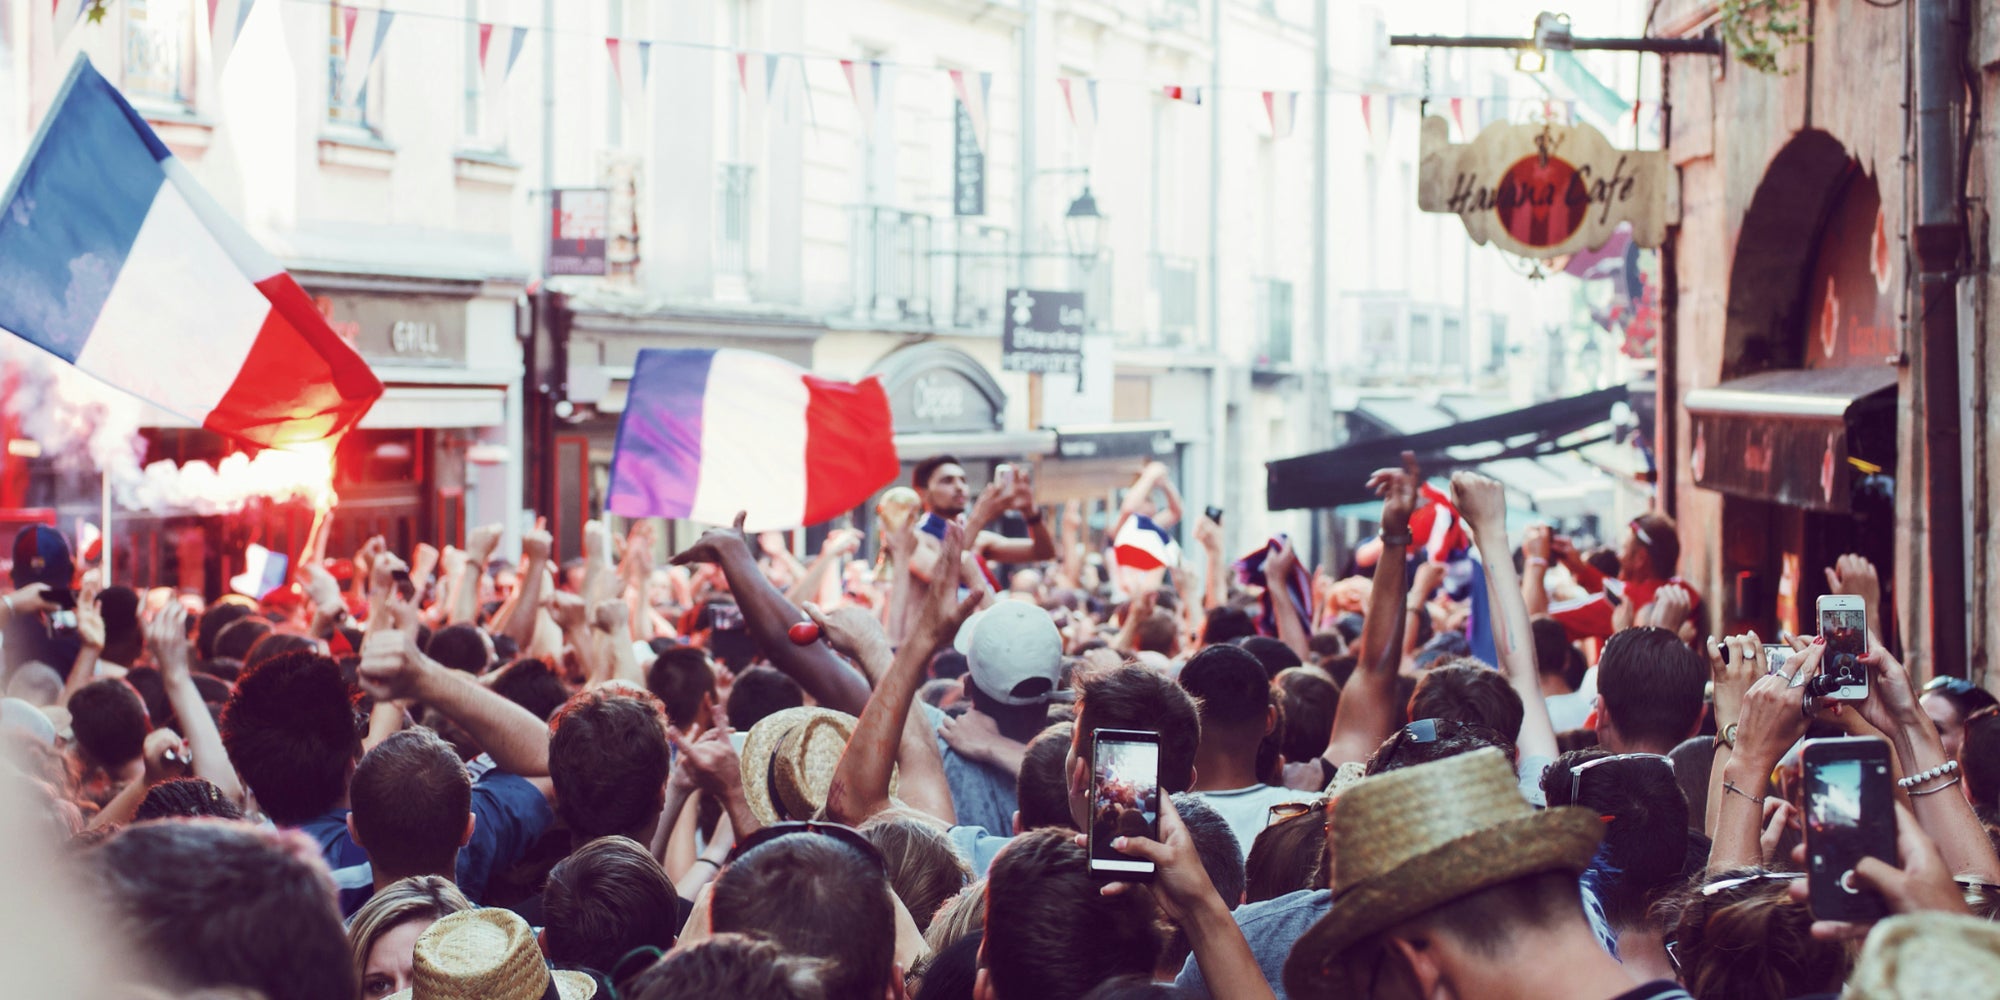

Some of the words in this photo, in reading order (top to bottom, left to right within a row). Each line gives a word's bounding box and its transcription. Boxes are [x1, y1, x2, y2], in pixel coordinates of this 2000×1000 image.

[1448, 173, 1556, 214] Havana
[1566, 154, 1638, 225] Café
[392, 320, 439, 353] GRILL
